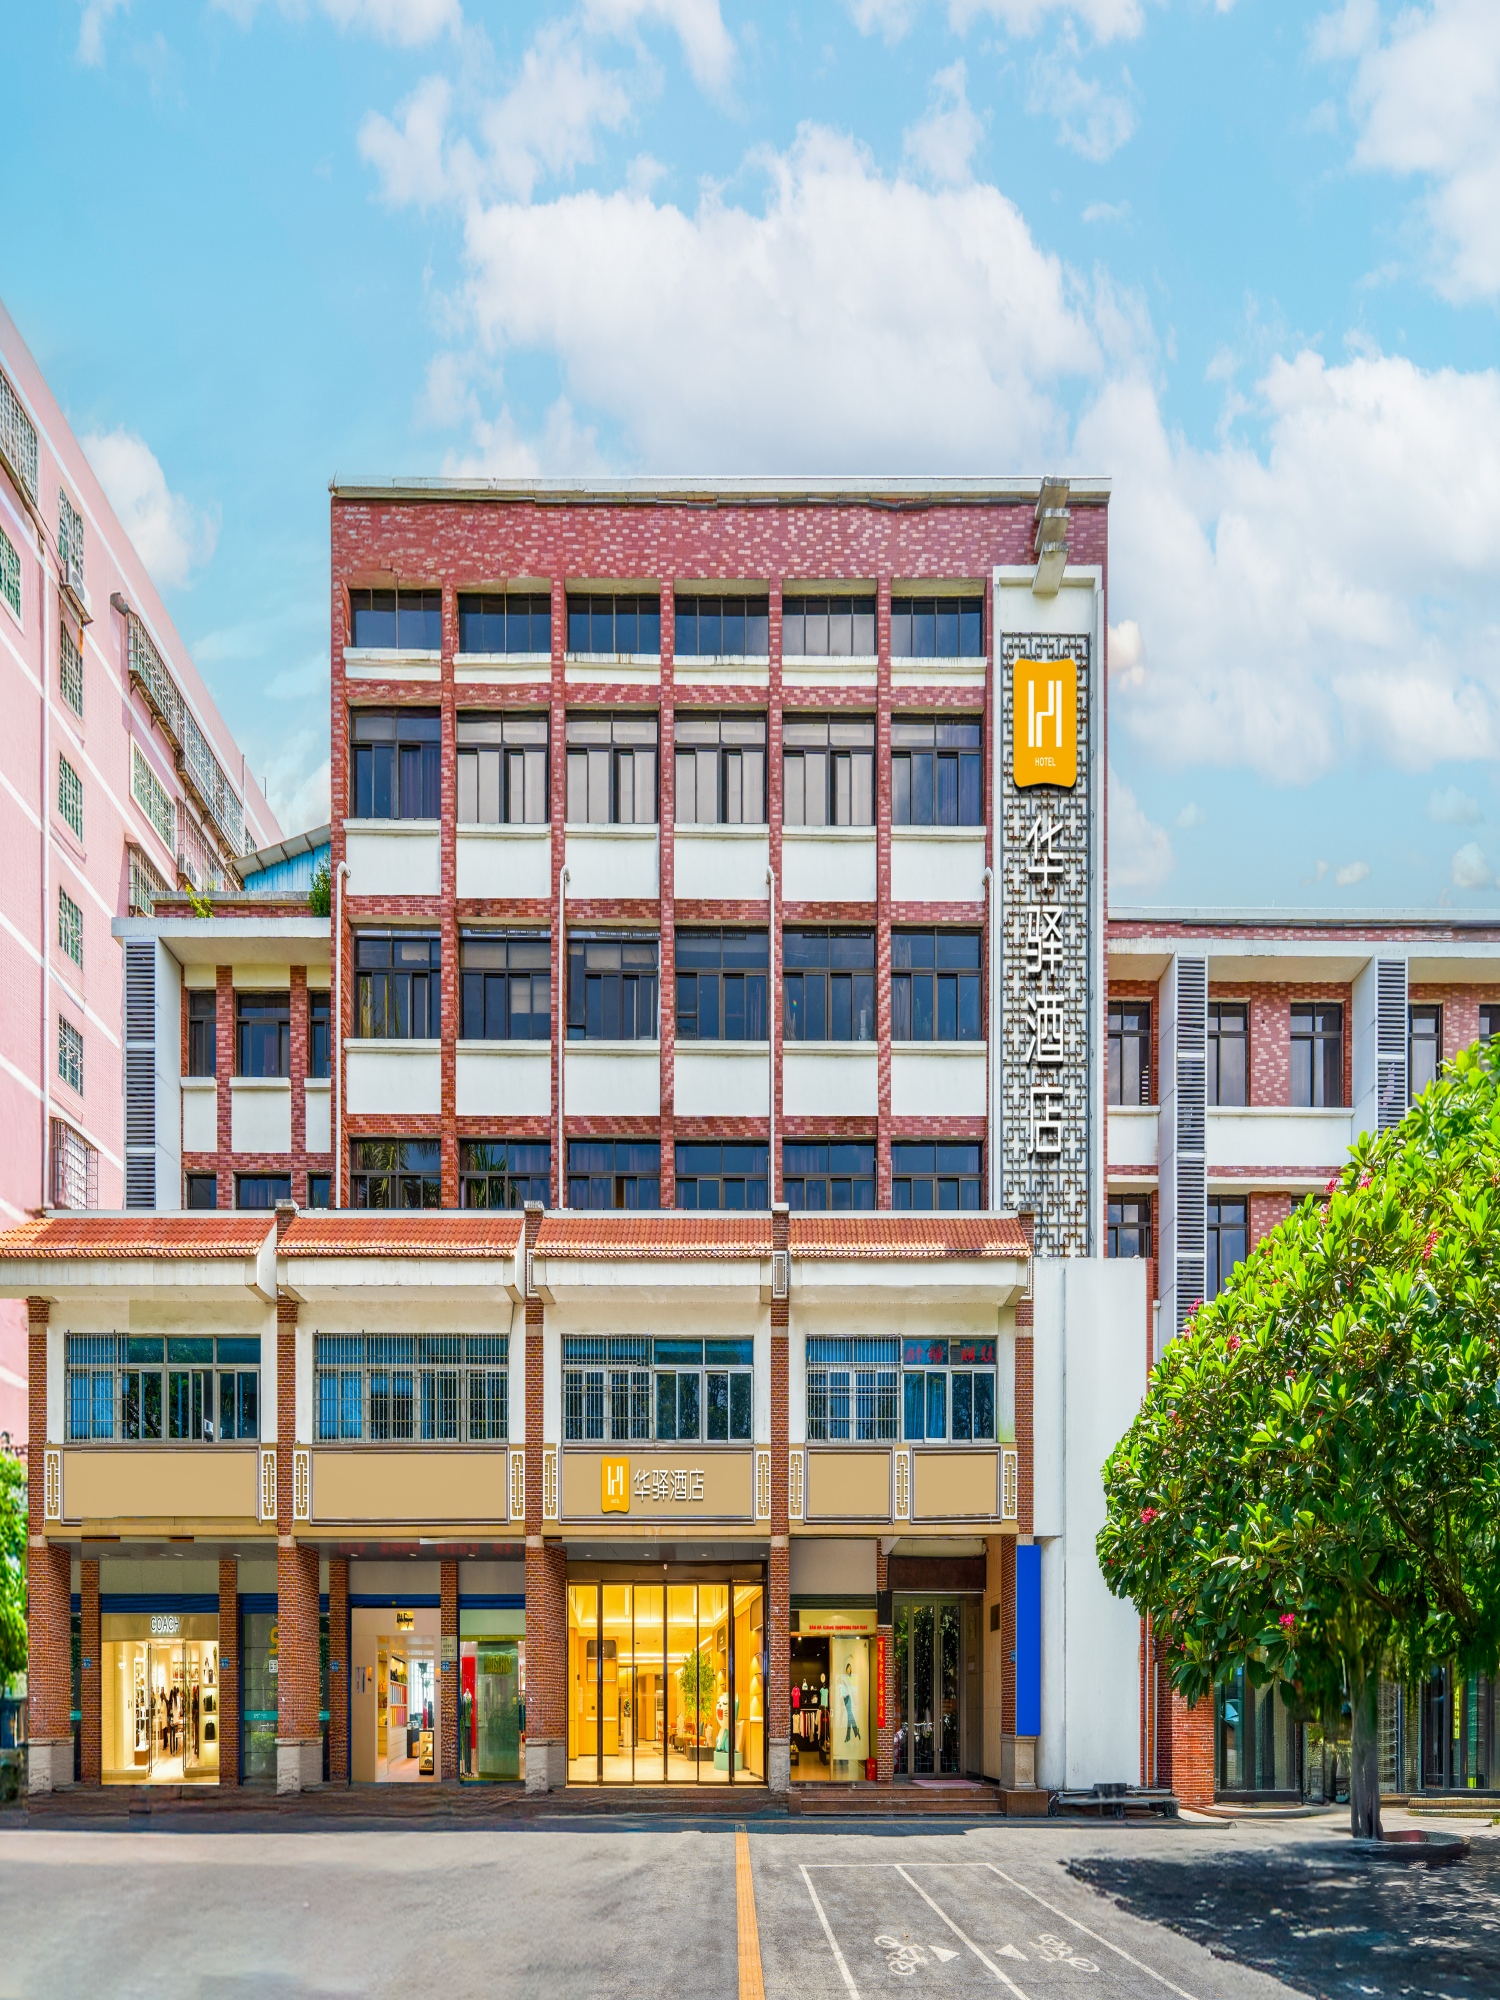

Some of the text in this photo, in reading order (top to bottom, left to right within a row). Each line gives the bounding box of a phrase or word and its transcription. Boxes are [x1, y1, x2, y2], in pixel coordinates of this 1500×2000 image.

[1035, 757, 1056, 766] HOTEL
[1026, 815, 1065, 1154] 华驿酒店
[633, 1467, 705, 1502] 华驿酒店
[150, 1616, 180, 1632] COACH
